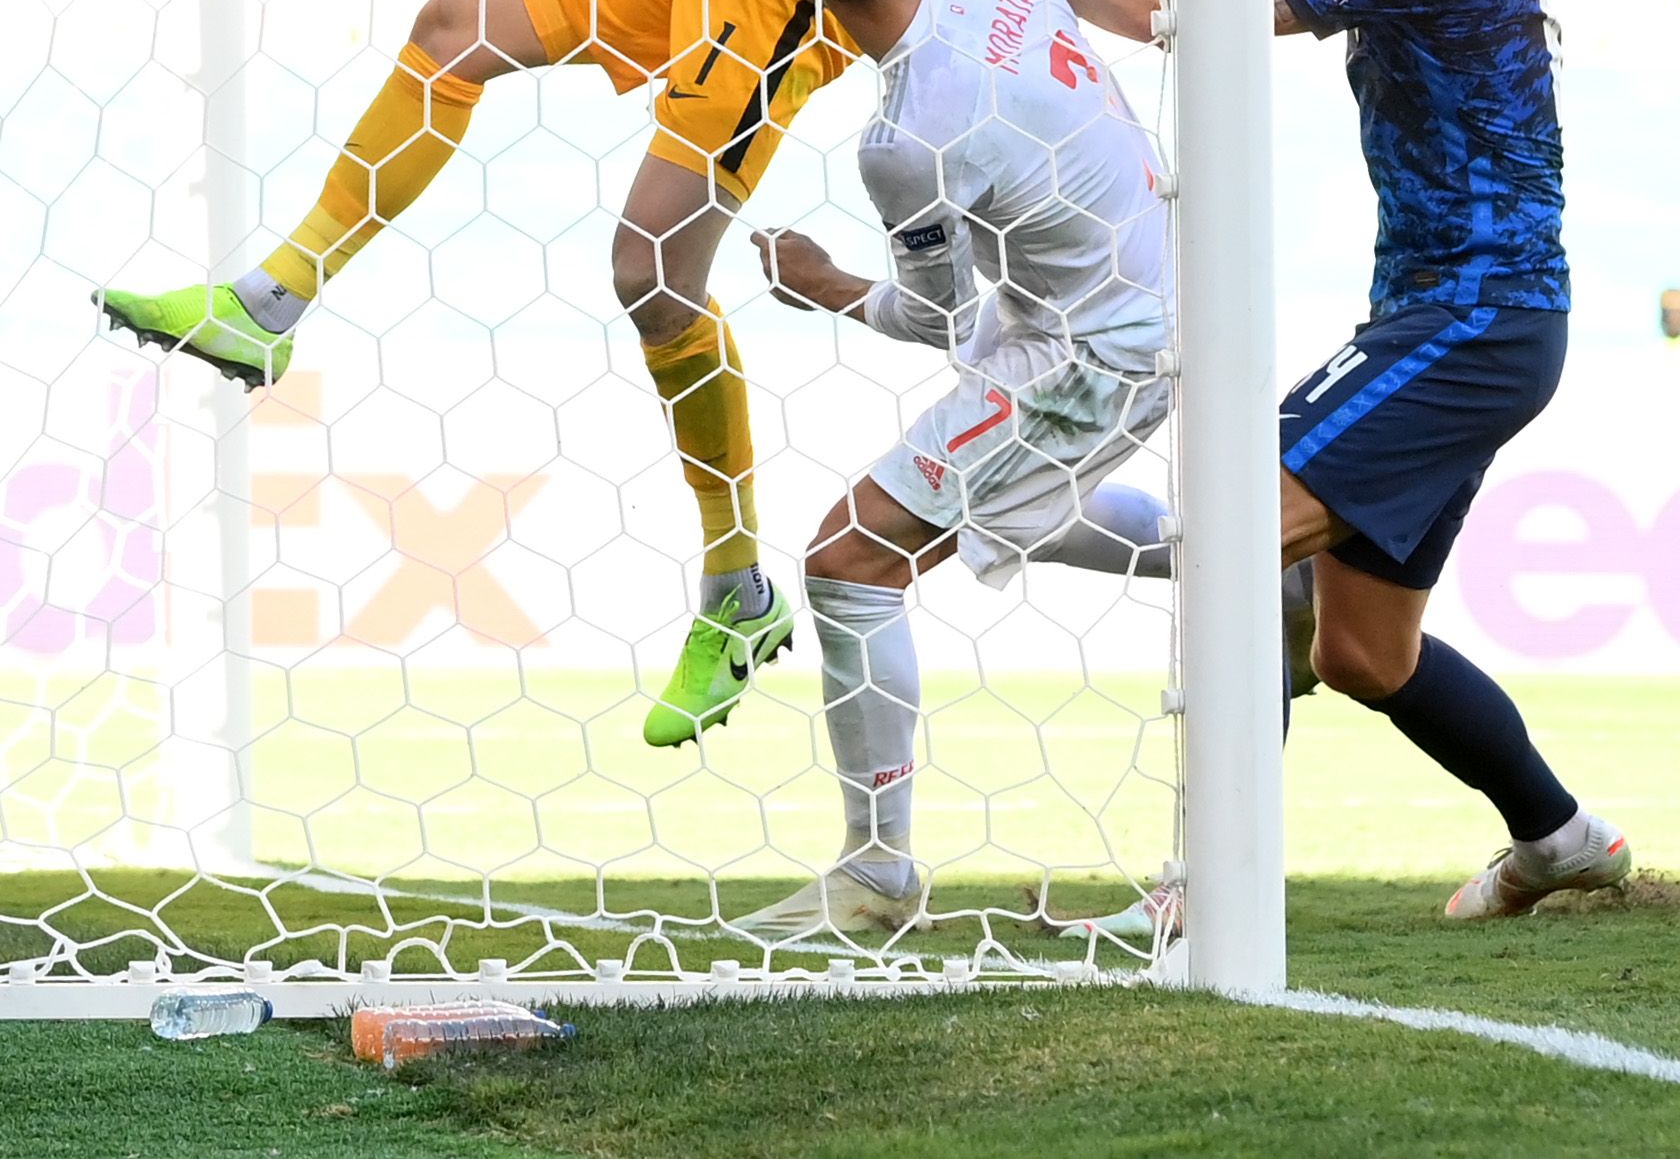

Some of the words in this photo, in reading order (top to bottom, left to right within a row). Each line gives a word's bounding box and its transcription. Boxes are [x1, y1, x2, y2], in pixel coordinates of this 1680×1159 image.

[1290, 343, 1369, 404] 4
[946, 388, 1013, 454] 7
[0, 370, 550, 654] dEx
